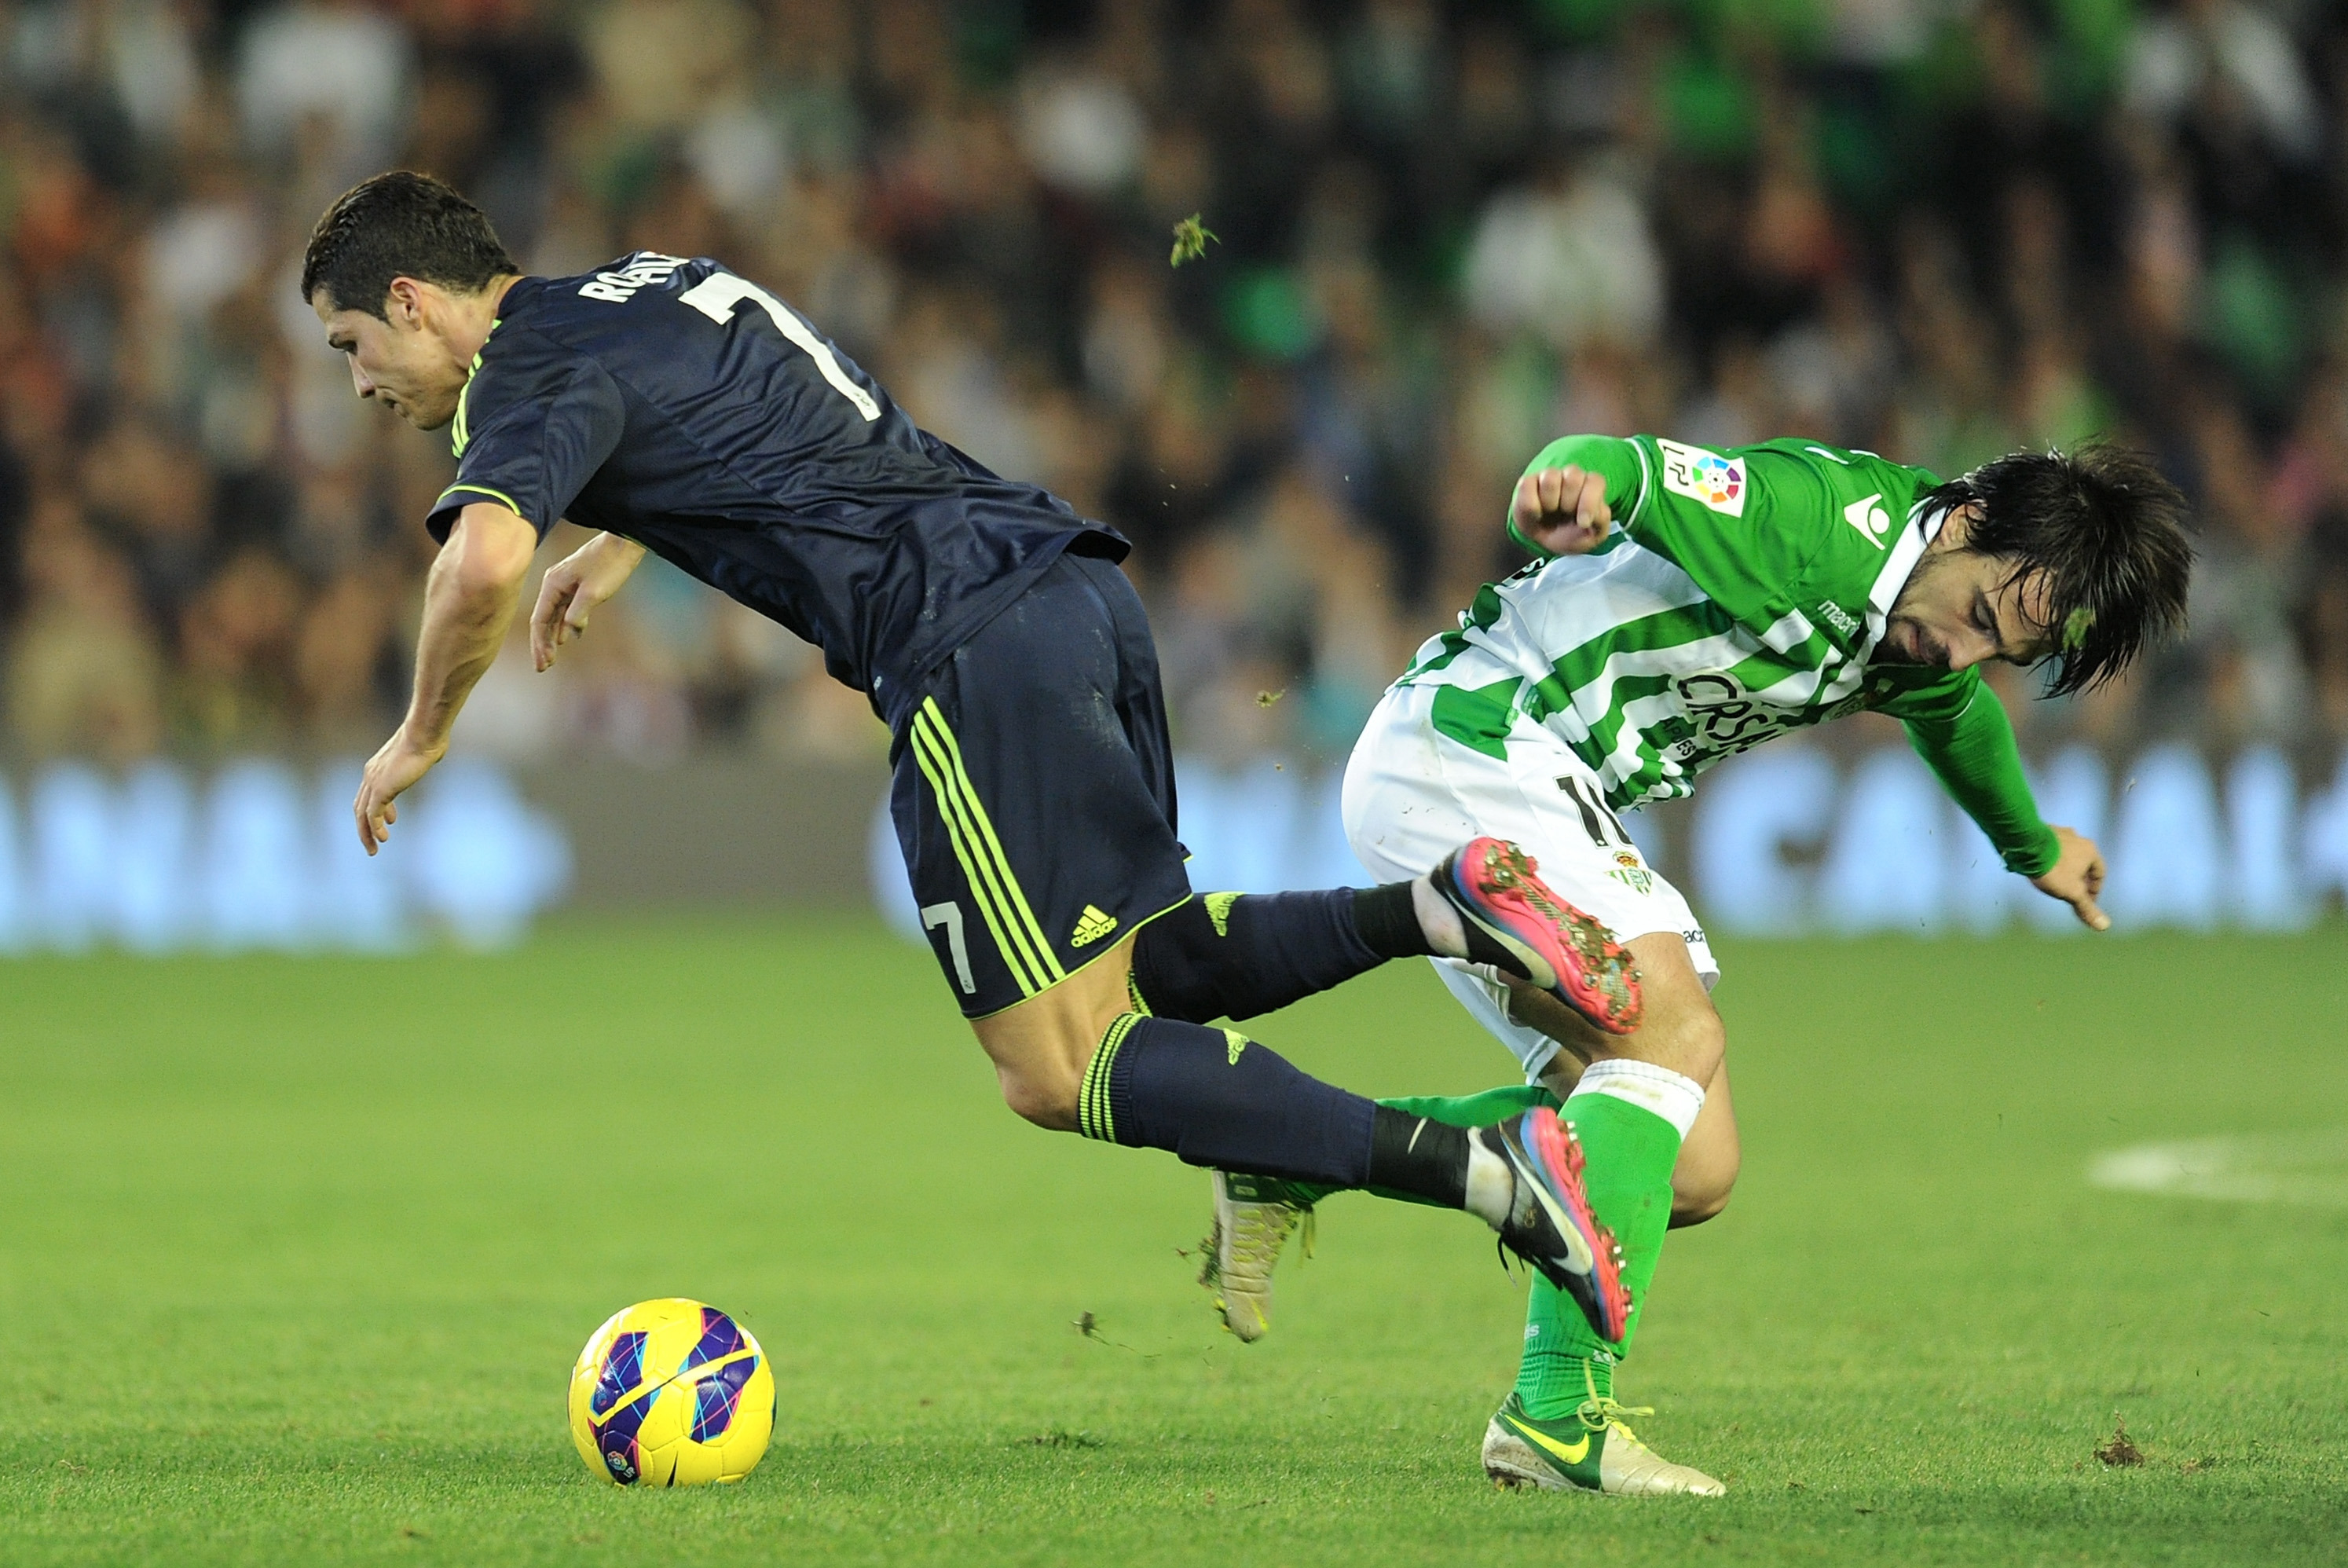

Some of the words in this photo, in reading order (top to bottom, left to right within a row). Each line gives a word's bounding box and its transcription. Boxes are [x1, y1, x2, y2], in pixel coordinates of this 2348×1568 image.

[678, 271, 881, 422] 7
[921, 901, 976, 995] 7
[1071, 917, 1118, 948] adidas
